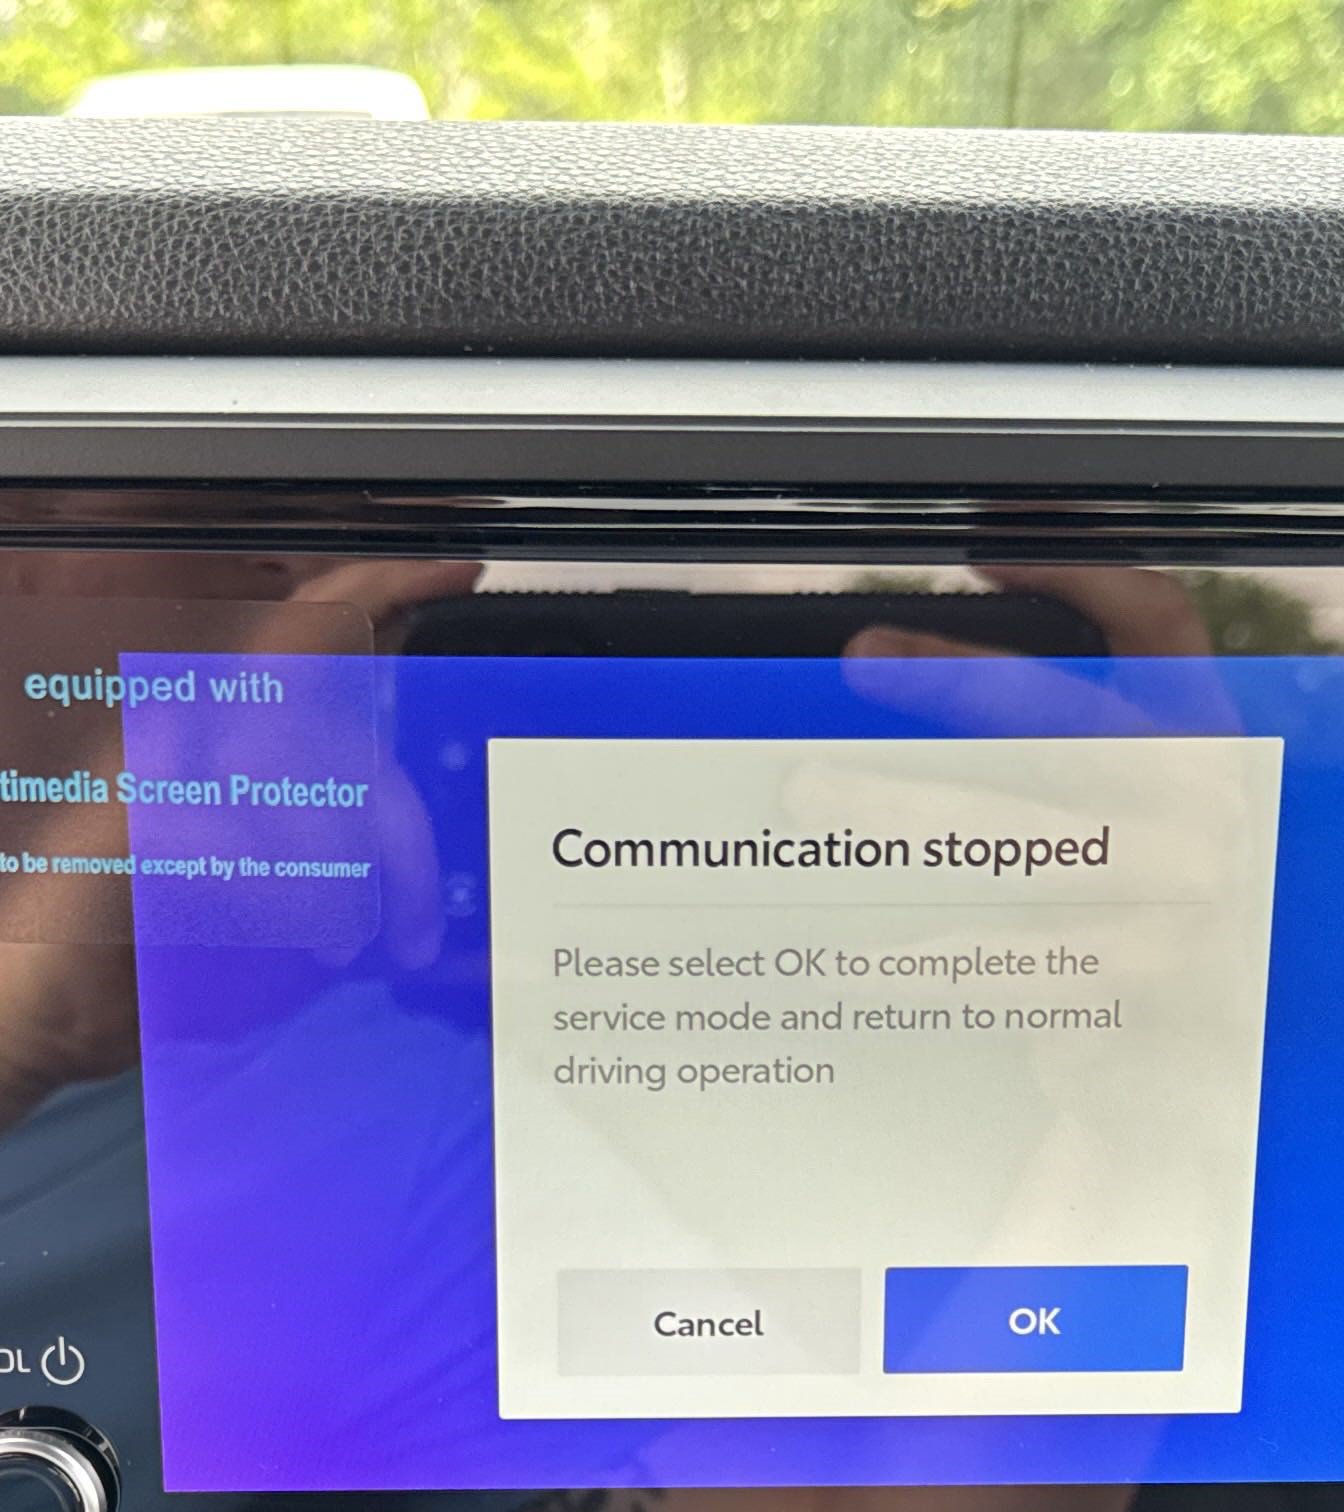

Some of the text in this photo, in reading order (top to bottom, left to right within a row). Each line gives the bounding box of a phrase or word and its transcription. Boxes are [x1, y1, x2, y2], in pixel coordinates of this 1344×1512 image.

[24, 668, 284, 708] equipped with
[116, 772, 222, 805] Screen
[230, 774, 369, 808] Protector
[22, 852, 48, 873] be
[51, 854, 137, 875] removed
[140, 856, 207, 880] except
[210, 856, 235, 881] by
[239, 857, 271, 877] the
[274, 860, 372, 878] consumer
[552, 825, 1110, 877] Communication stopped
[553, 945, 1100, 985] Please select OK to complete the
[553, 999, 1123, 1031] service mode and return to normal
[553, 1055, 835, 1092] driving operation
[653, 1309, 765, 1338] Cancel
[1007, 1307, 1063, 1336] OK
